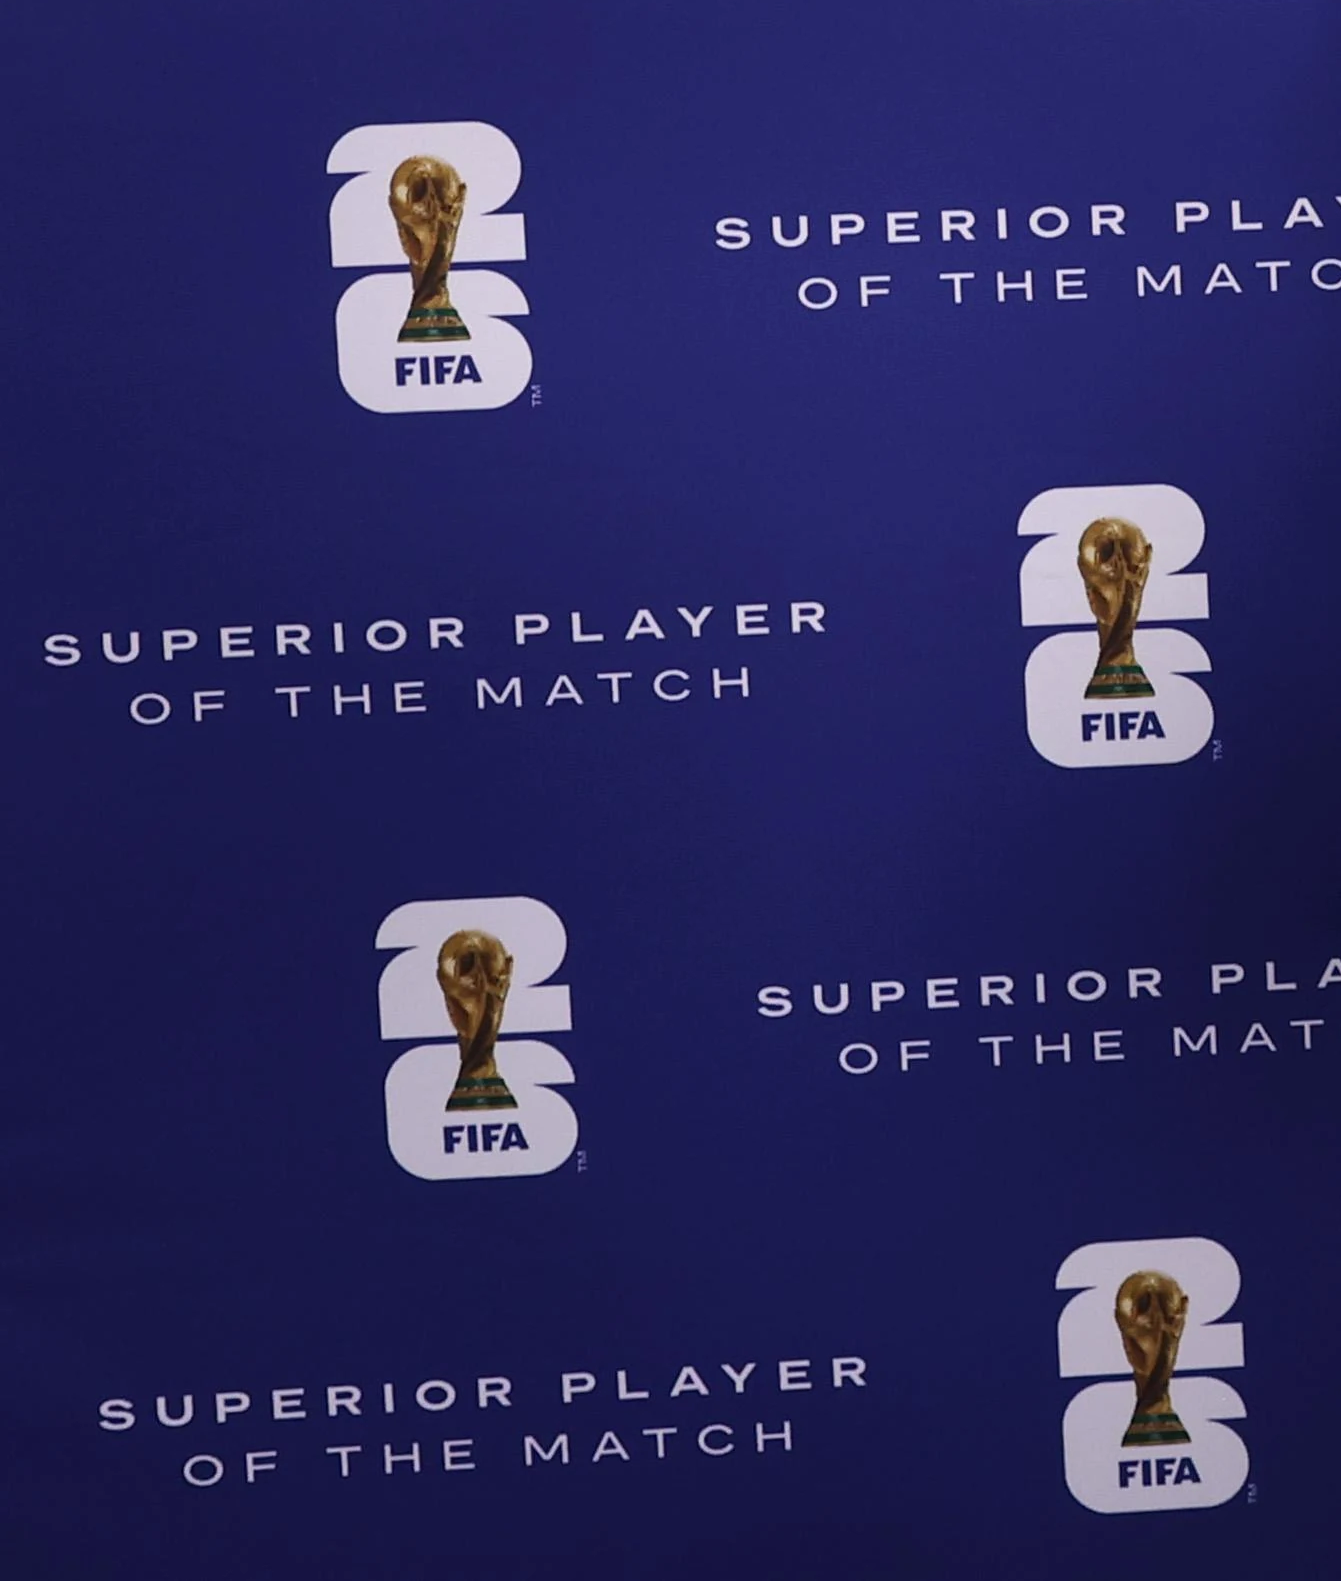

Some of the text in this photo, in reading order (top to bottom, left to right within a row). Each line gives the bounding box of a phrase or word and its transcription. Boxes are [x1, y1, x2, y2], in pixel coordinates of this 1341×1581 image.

[715, 203, 1126, 251] SUPERIOR
[797, 274, 892, 310] OF
[938, 267, 1089, 304] THE
[394, 354, 483, 387] FIFA
[44, 601, 826, 667] SUPERIOR PLAYER
[130, 666, 750, 725] OF THE MATCH
[1081, 710, 1166, 742] FIFA
[757, 967, 1162, 1018] SUPERIOR
[838, 1039, 931, 1075] OF
[978, 1030, 1125, 1067] THE
[443, 1122, 529, 1154] FIFA
[99, 1356, 866, 1431] SUPERIOR PLAYER
[183, 1420, 792, 1487] OF THE MATCH
[1118, 1456, 1201, 1489] FIFA
